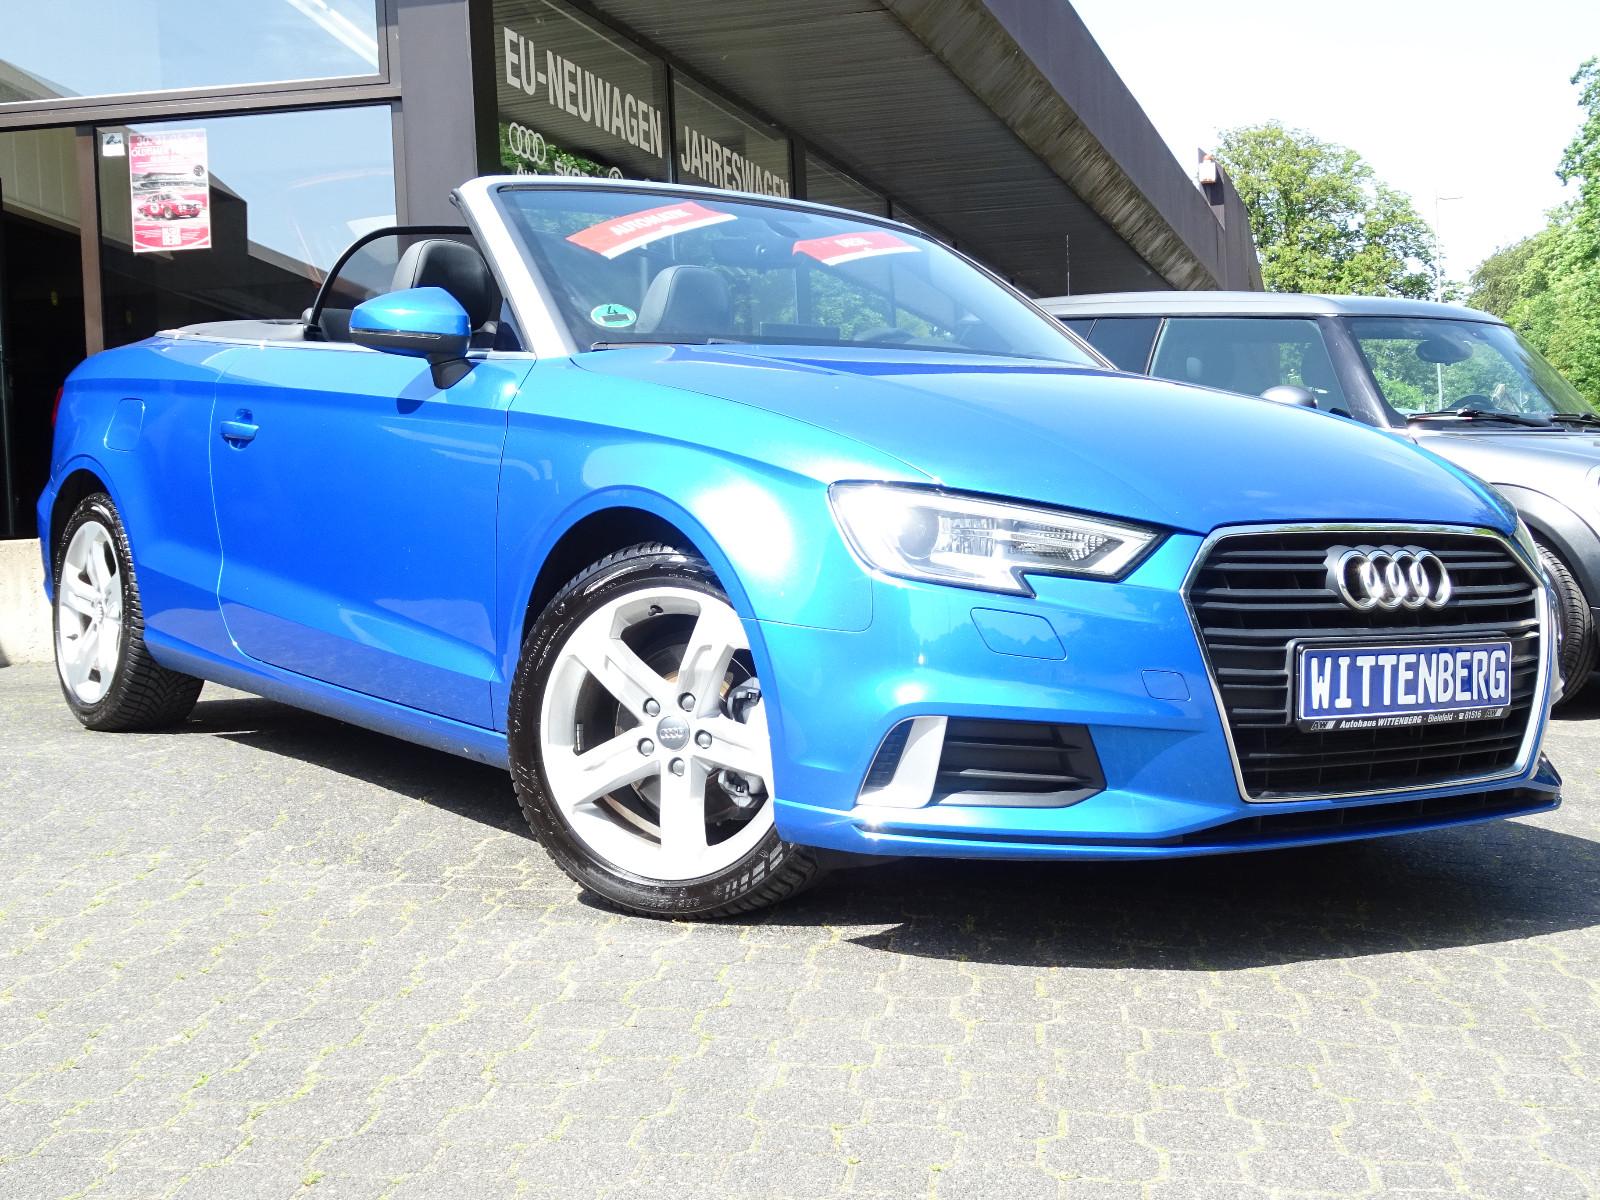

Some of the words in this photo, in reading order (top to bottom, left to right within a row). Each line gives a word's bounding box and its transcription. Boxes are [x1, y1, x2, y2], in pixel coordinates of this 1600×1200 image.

[503, 26, 663, 158] EU-NEUWAGEN
[681, 125, 791, 199] JAHRESWAGEN
[1310, 649, 1507, 710] WITTENBERG
[1340, 719, 1377, 729] Autohaus
[1378, 715, 1423, 727] WITTENBERG
[1427, 712, 1454, 723] Bielefeld
